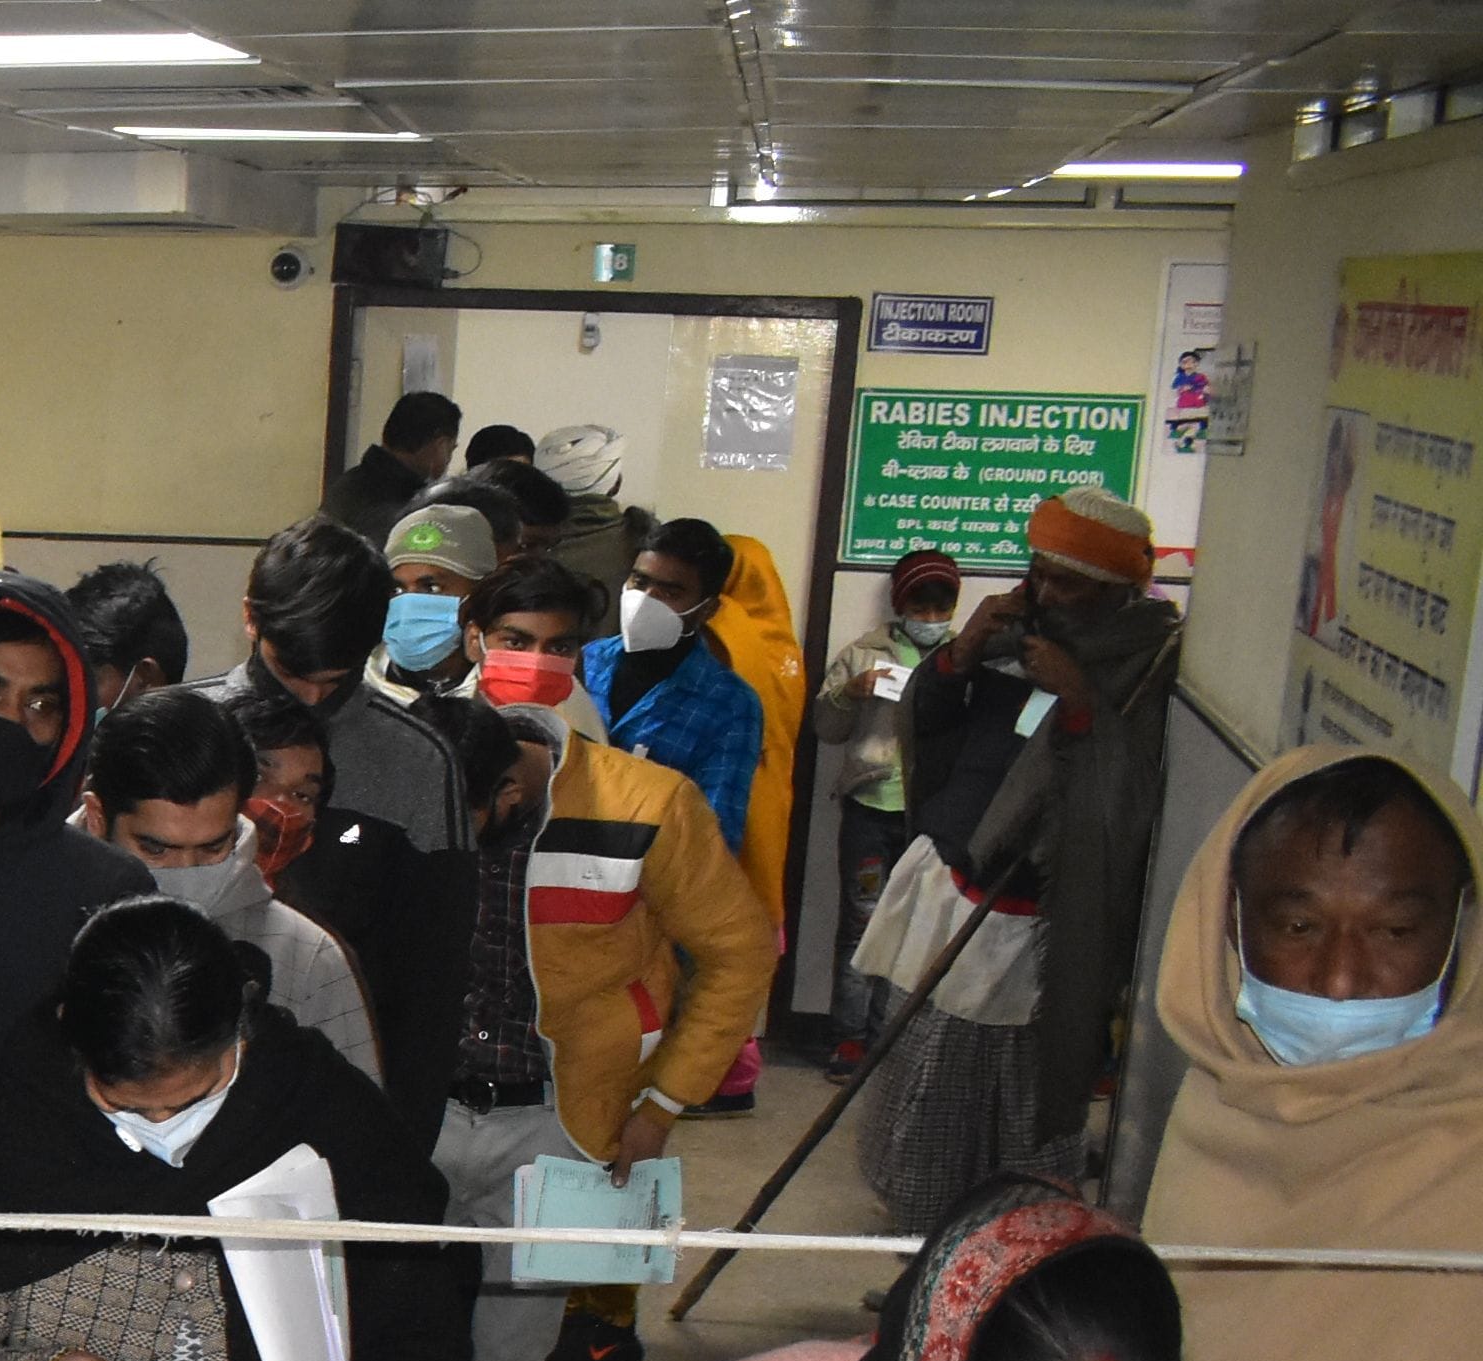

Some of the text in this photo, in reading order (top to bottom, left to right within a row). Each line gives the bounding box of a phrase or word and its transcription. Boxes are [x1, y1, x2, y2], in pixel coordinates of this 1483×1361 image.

[879, 300, 986, 323] INJECTION ROOM
[881, 321, 978, 344] टीकाकरण
[870, 400, 1130, 431] RABIES INJECTION
[942, 431, 979, 450] टीका
[1043, 435, 1060, 452] के
[1064, 434, 1096, 455] लिए
[953, 461, 971, 480] के
[979, 467, 1047, 484] (GROUND
[1050, 469, 1104, 487] FLOOR)
[879, 494, 917, 508] CASE
[920, 495, 991, 511] COUNTER
[1012, 493, 1041, 513] रसी
[897, 518, 923, 530] BPL
